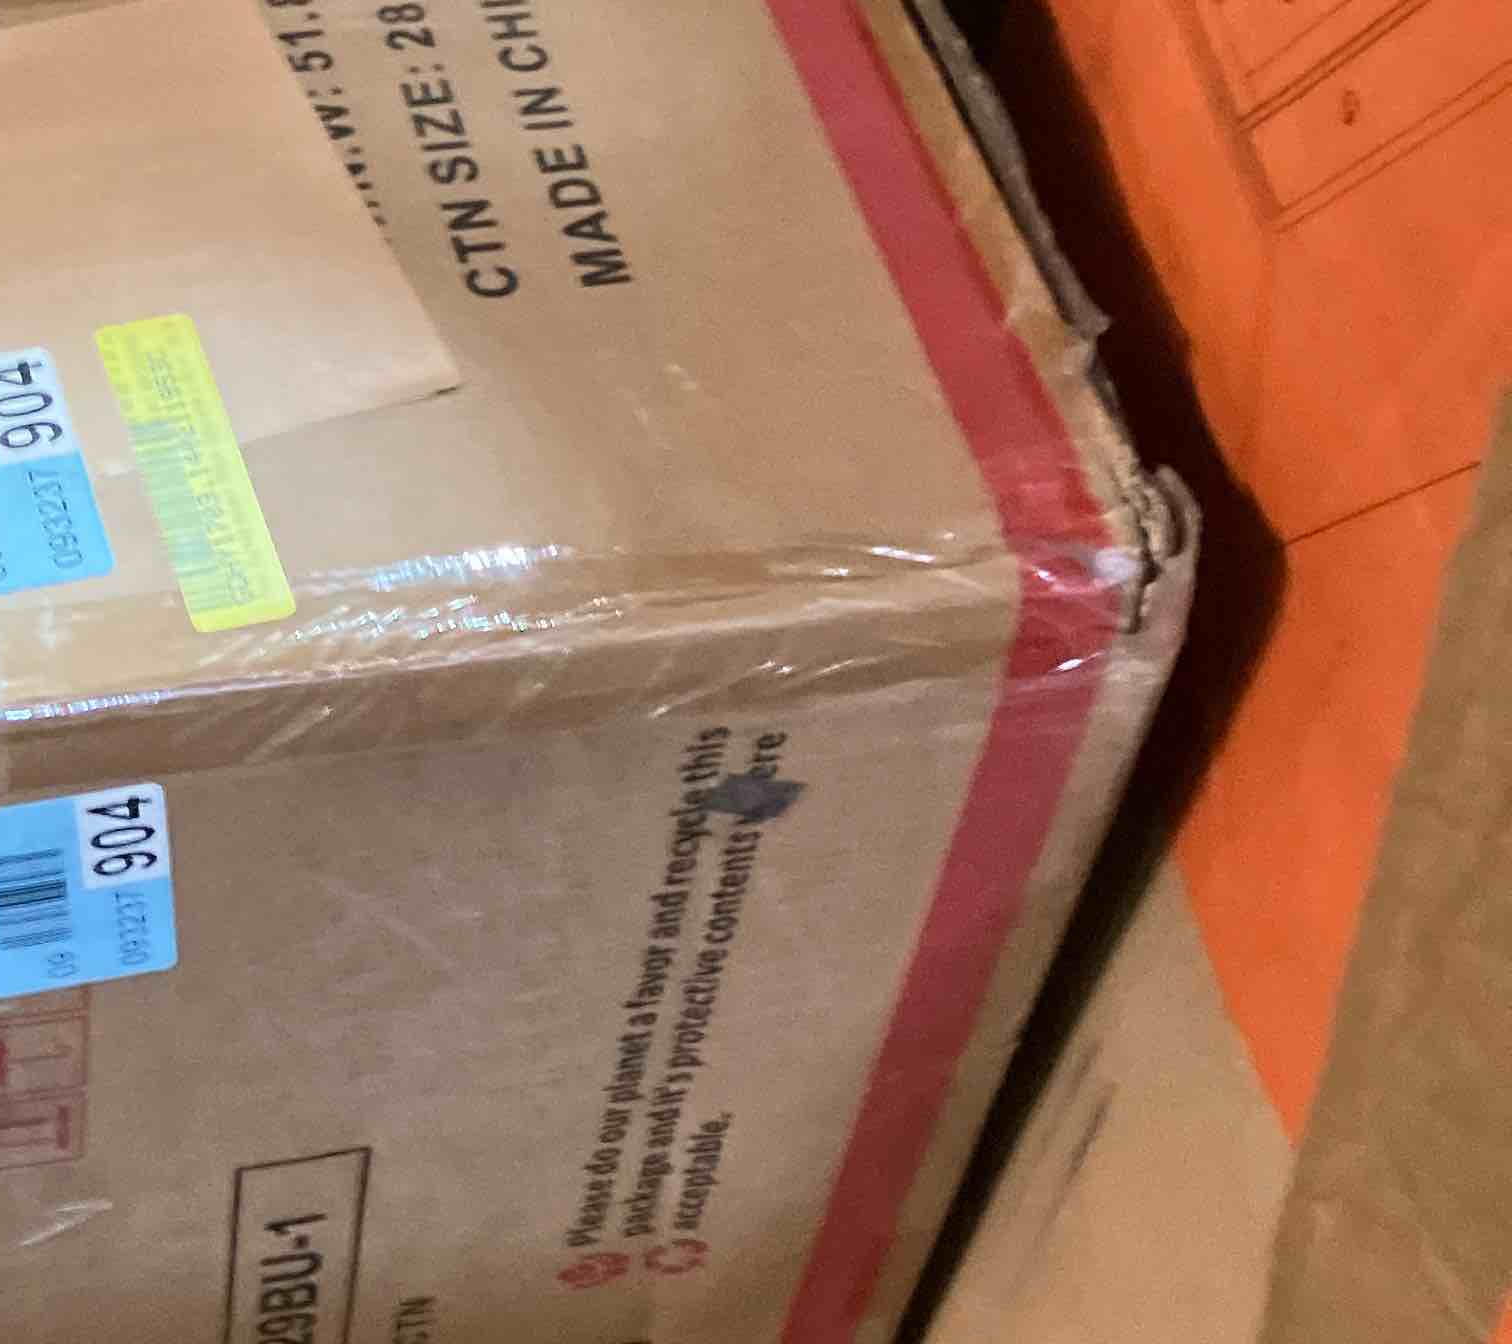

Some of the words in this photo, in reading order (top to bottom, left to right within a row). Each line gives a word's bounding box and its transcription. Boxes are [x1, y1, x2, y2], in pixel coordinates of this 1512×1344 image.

[399, 62, 480, 185] SIZE:
[512, 86, 575, 132] IN
[440, 198, 519, 299] CTN
[532, 143, 632, 288] MADE
[675, 725, 733, 784] this
[86, 796, 159, 877] 904
[664, 788, 714, 888] recycle
[649, 889, 692, 941] and
[704, 830, 764, 945] contents
[620, 945, 678, 1010] favor
[666, 948, 730, 1068] protective
[625, 1011, 660, 1027] a
[600, 1030, 654, 1103] planet
[582, 1146, 623, 1176] do
[598, 1107, 633, 1144] our
[644, 1106, 681, 1148] and
[564, 1179, 616, 1248] Please
[620, 1150, 675, 1238] package
